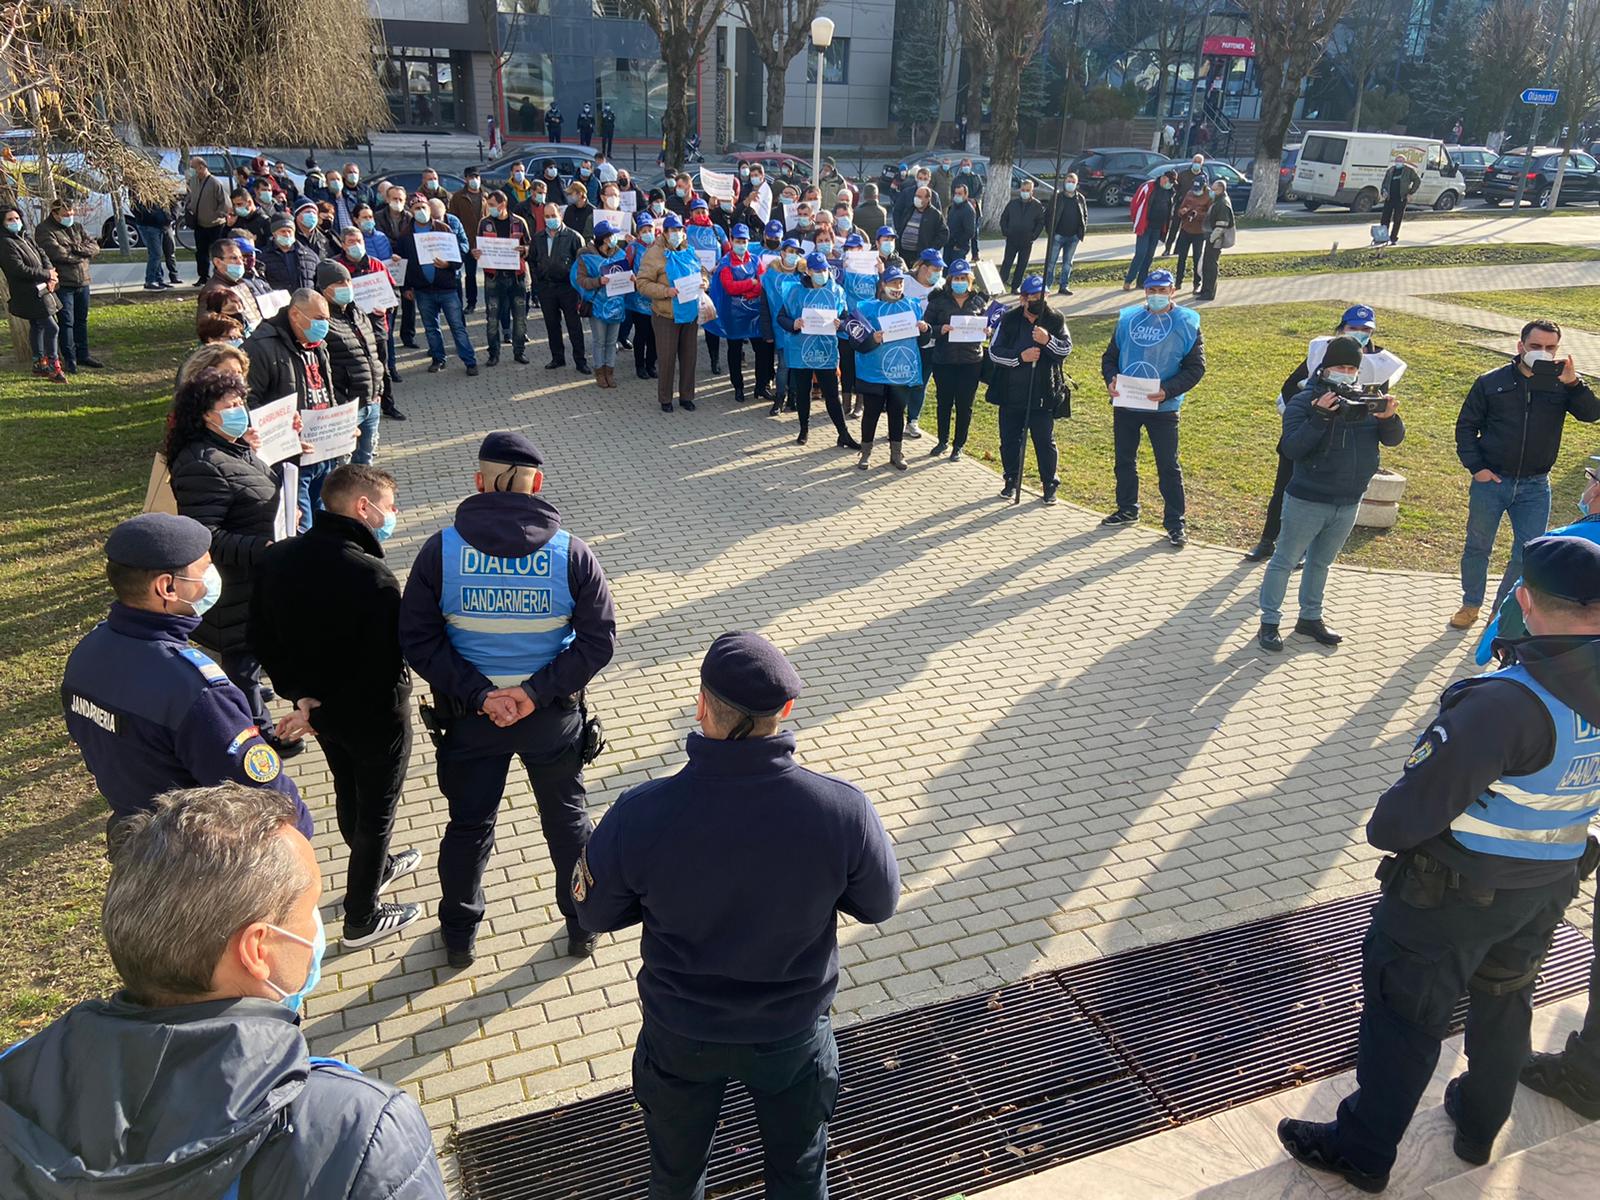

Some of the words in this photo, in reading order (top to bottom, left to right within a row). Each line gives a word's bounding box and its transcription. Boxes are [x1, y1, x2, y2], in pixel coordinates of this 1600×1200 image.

[1137, 323, 1160, 334] alfa
[890, 362, 911, 372] alfa
[463, 548, 549, 575] DIALOG
[463, 589, 550, 613] JANDARMERIA
